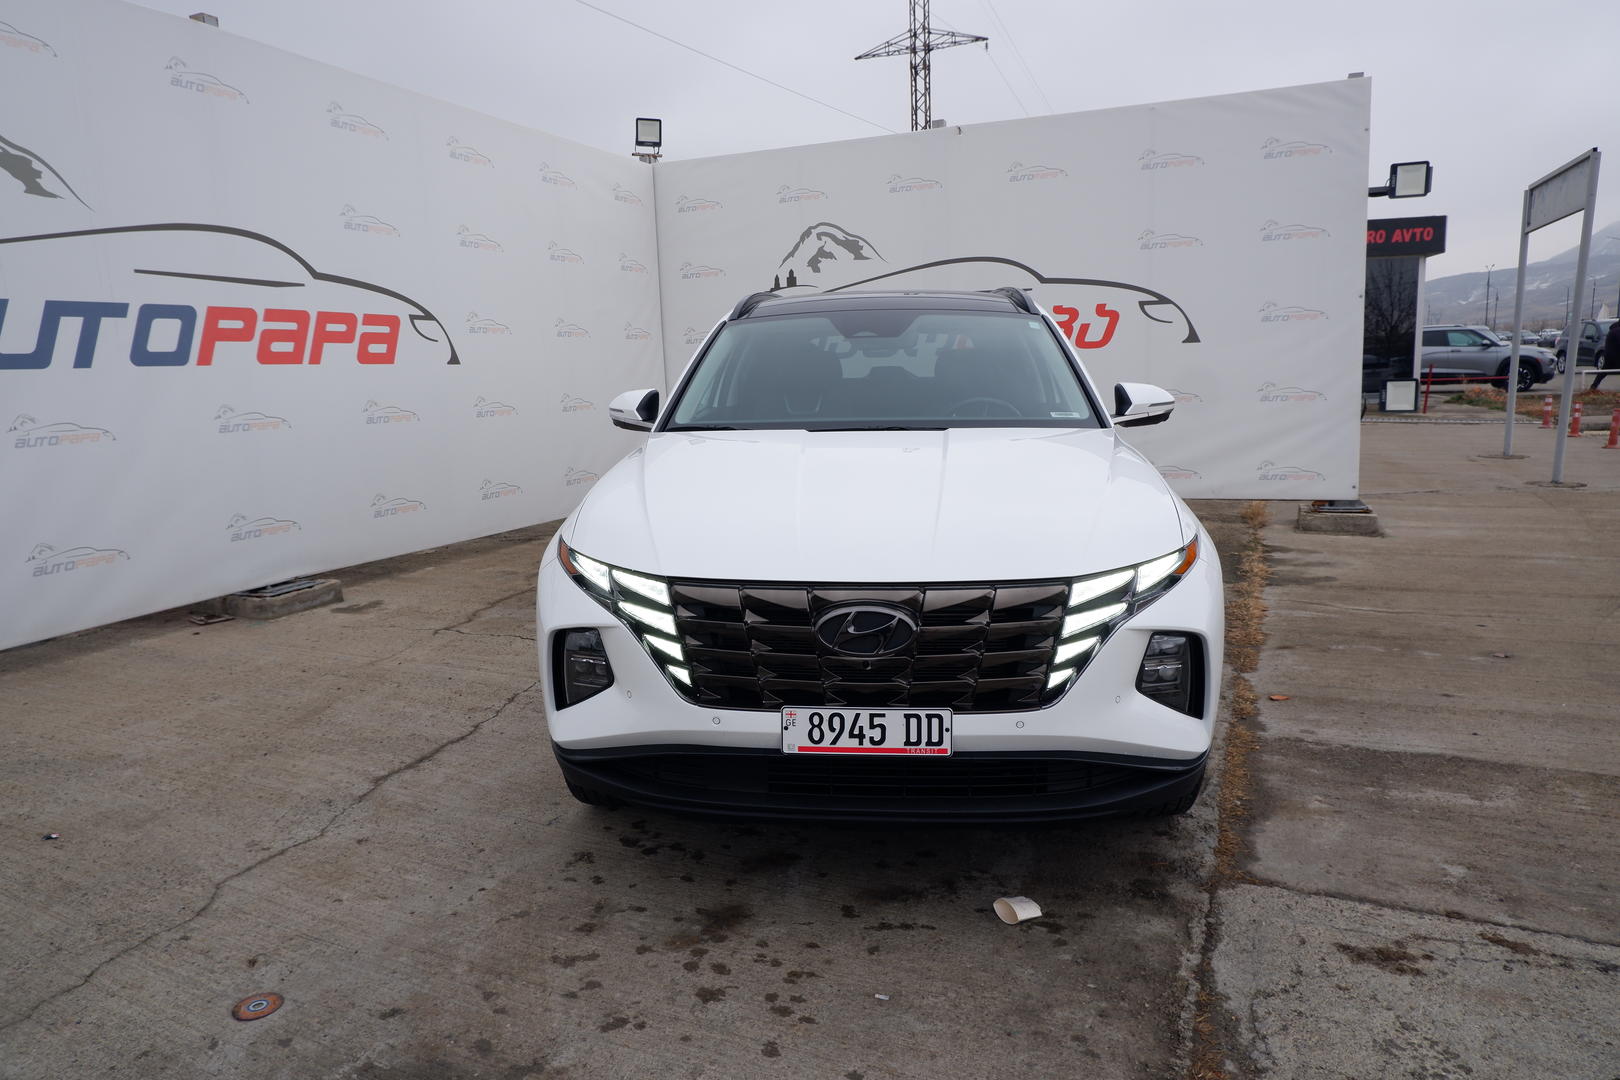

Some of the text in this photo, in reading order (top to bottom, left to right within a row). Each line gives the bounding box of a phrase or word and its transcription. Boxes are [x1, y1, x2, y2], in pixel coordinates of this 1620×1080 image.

[1391, 227, 1434, 243] AVTO
[785, 718, 796, 727] GE
[807, 711, 944, 747] 8945 DD
[906, 747, 939, 755] TRANSIT
